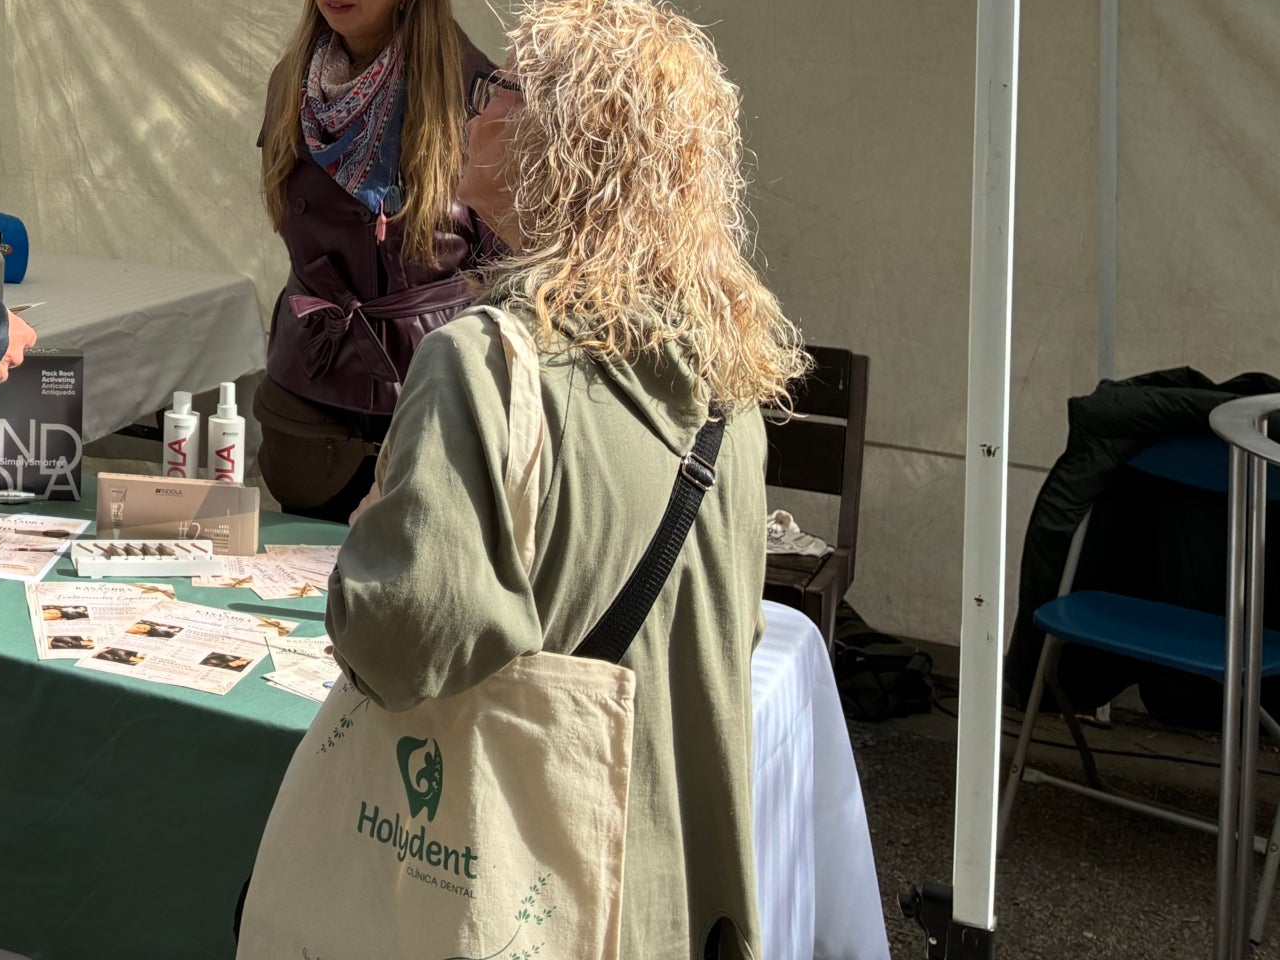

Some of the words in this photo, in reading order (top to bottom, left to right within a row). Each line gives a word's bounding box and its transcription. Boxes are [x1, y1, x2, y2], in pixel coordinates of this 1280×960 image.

[41, 376, 75, 384] Activating
[356, 800, 478, 879] Holydent
[440, 879, 477, 900] DENTAL
